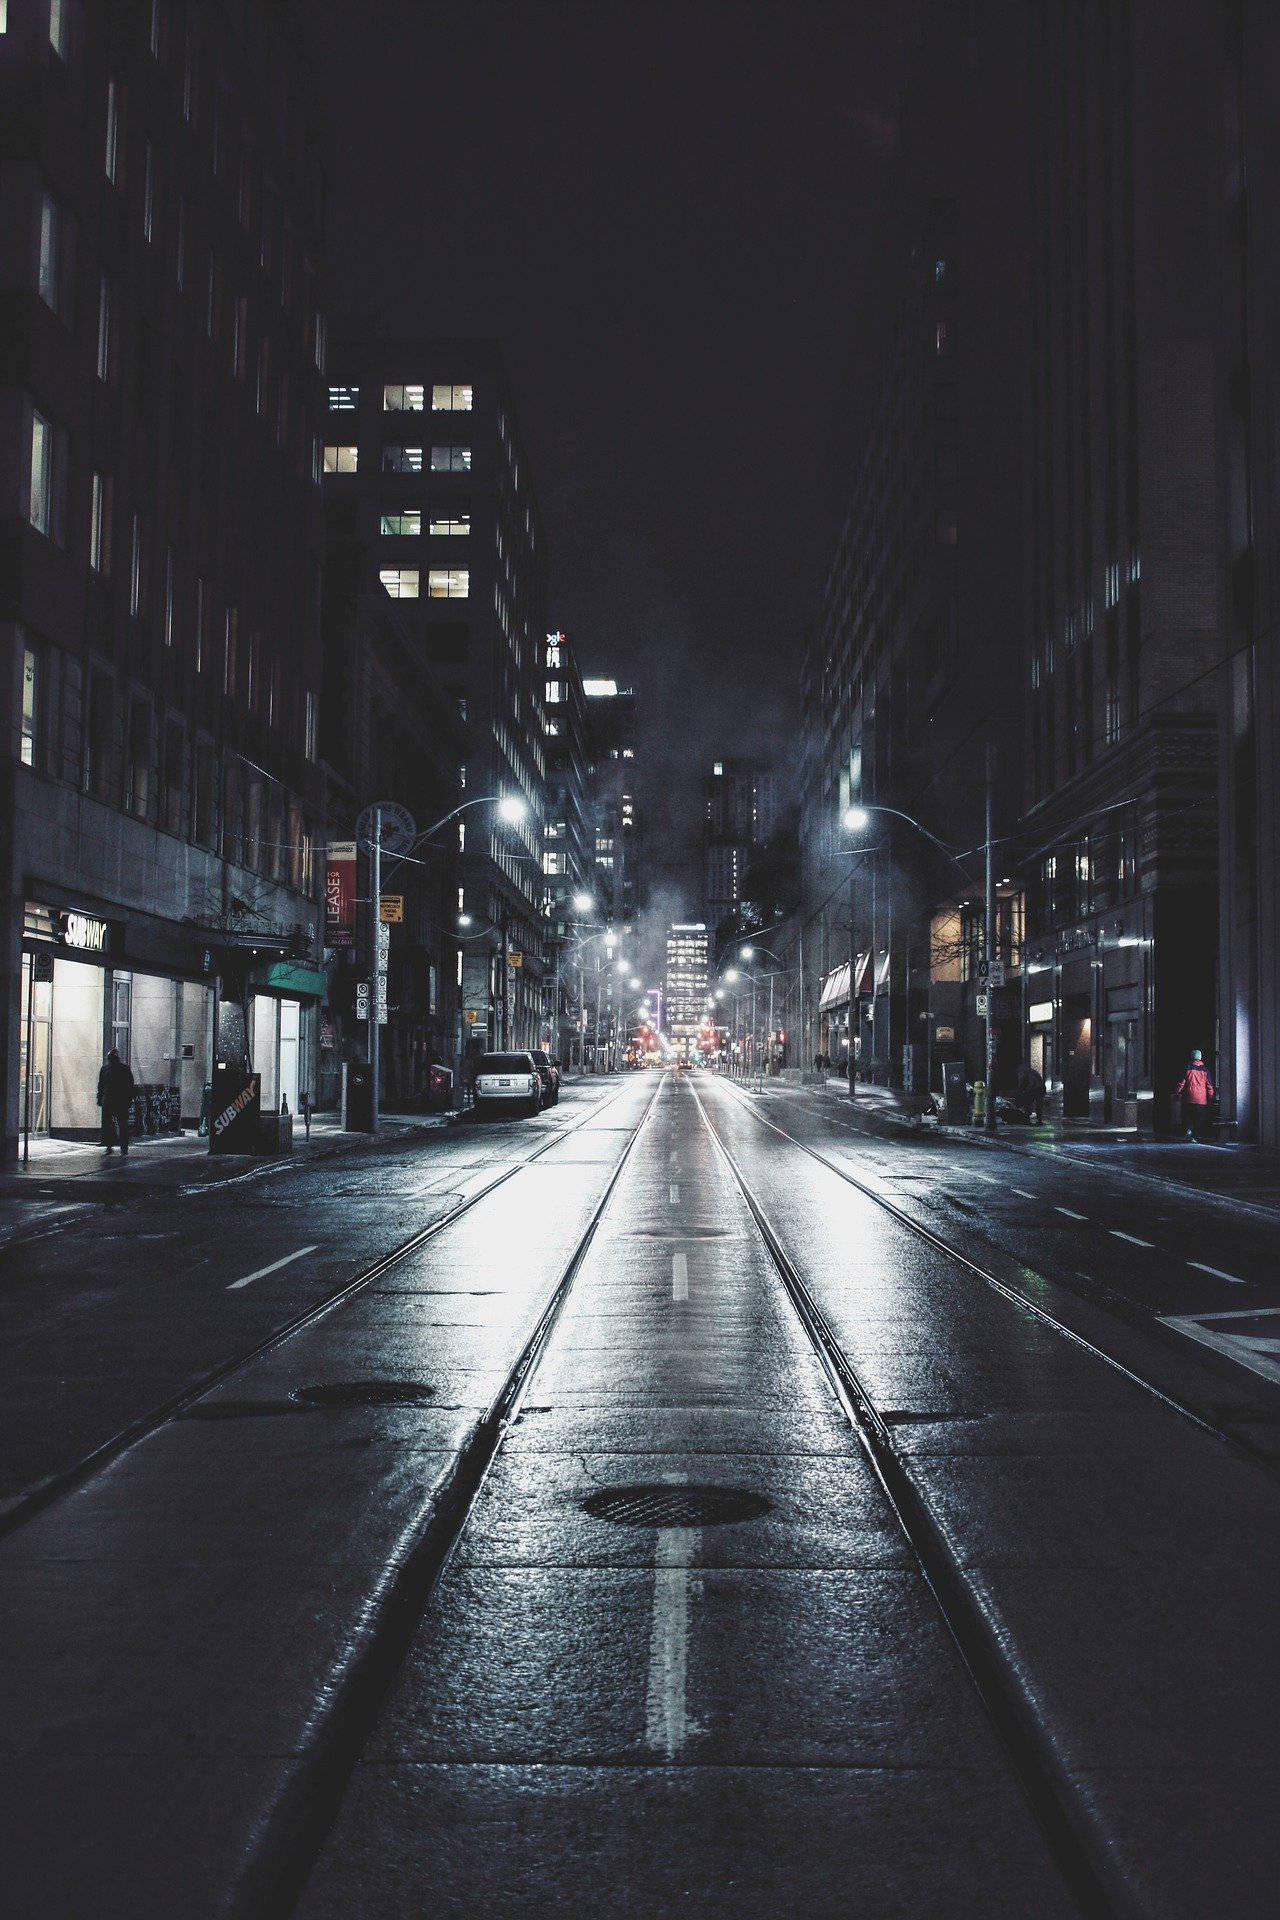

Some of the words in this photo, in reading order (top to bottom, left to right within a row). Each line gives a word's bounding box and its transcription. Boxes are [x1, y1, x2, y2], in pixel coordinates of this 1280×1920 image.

[327, 878, 340, 924] LEASE
[64, 913, 107, 950] SUBWAY
[214, 1080, 256, 1135] SUBWAY
